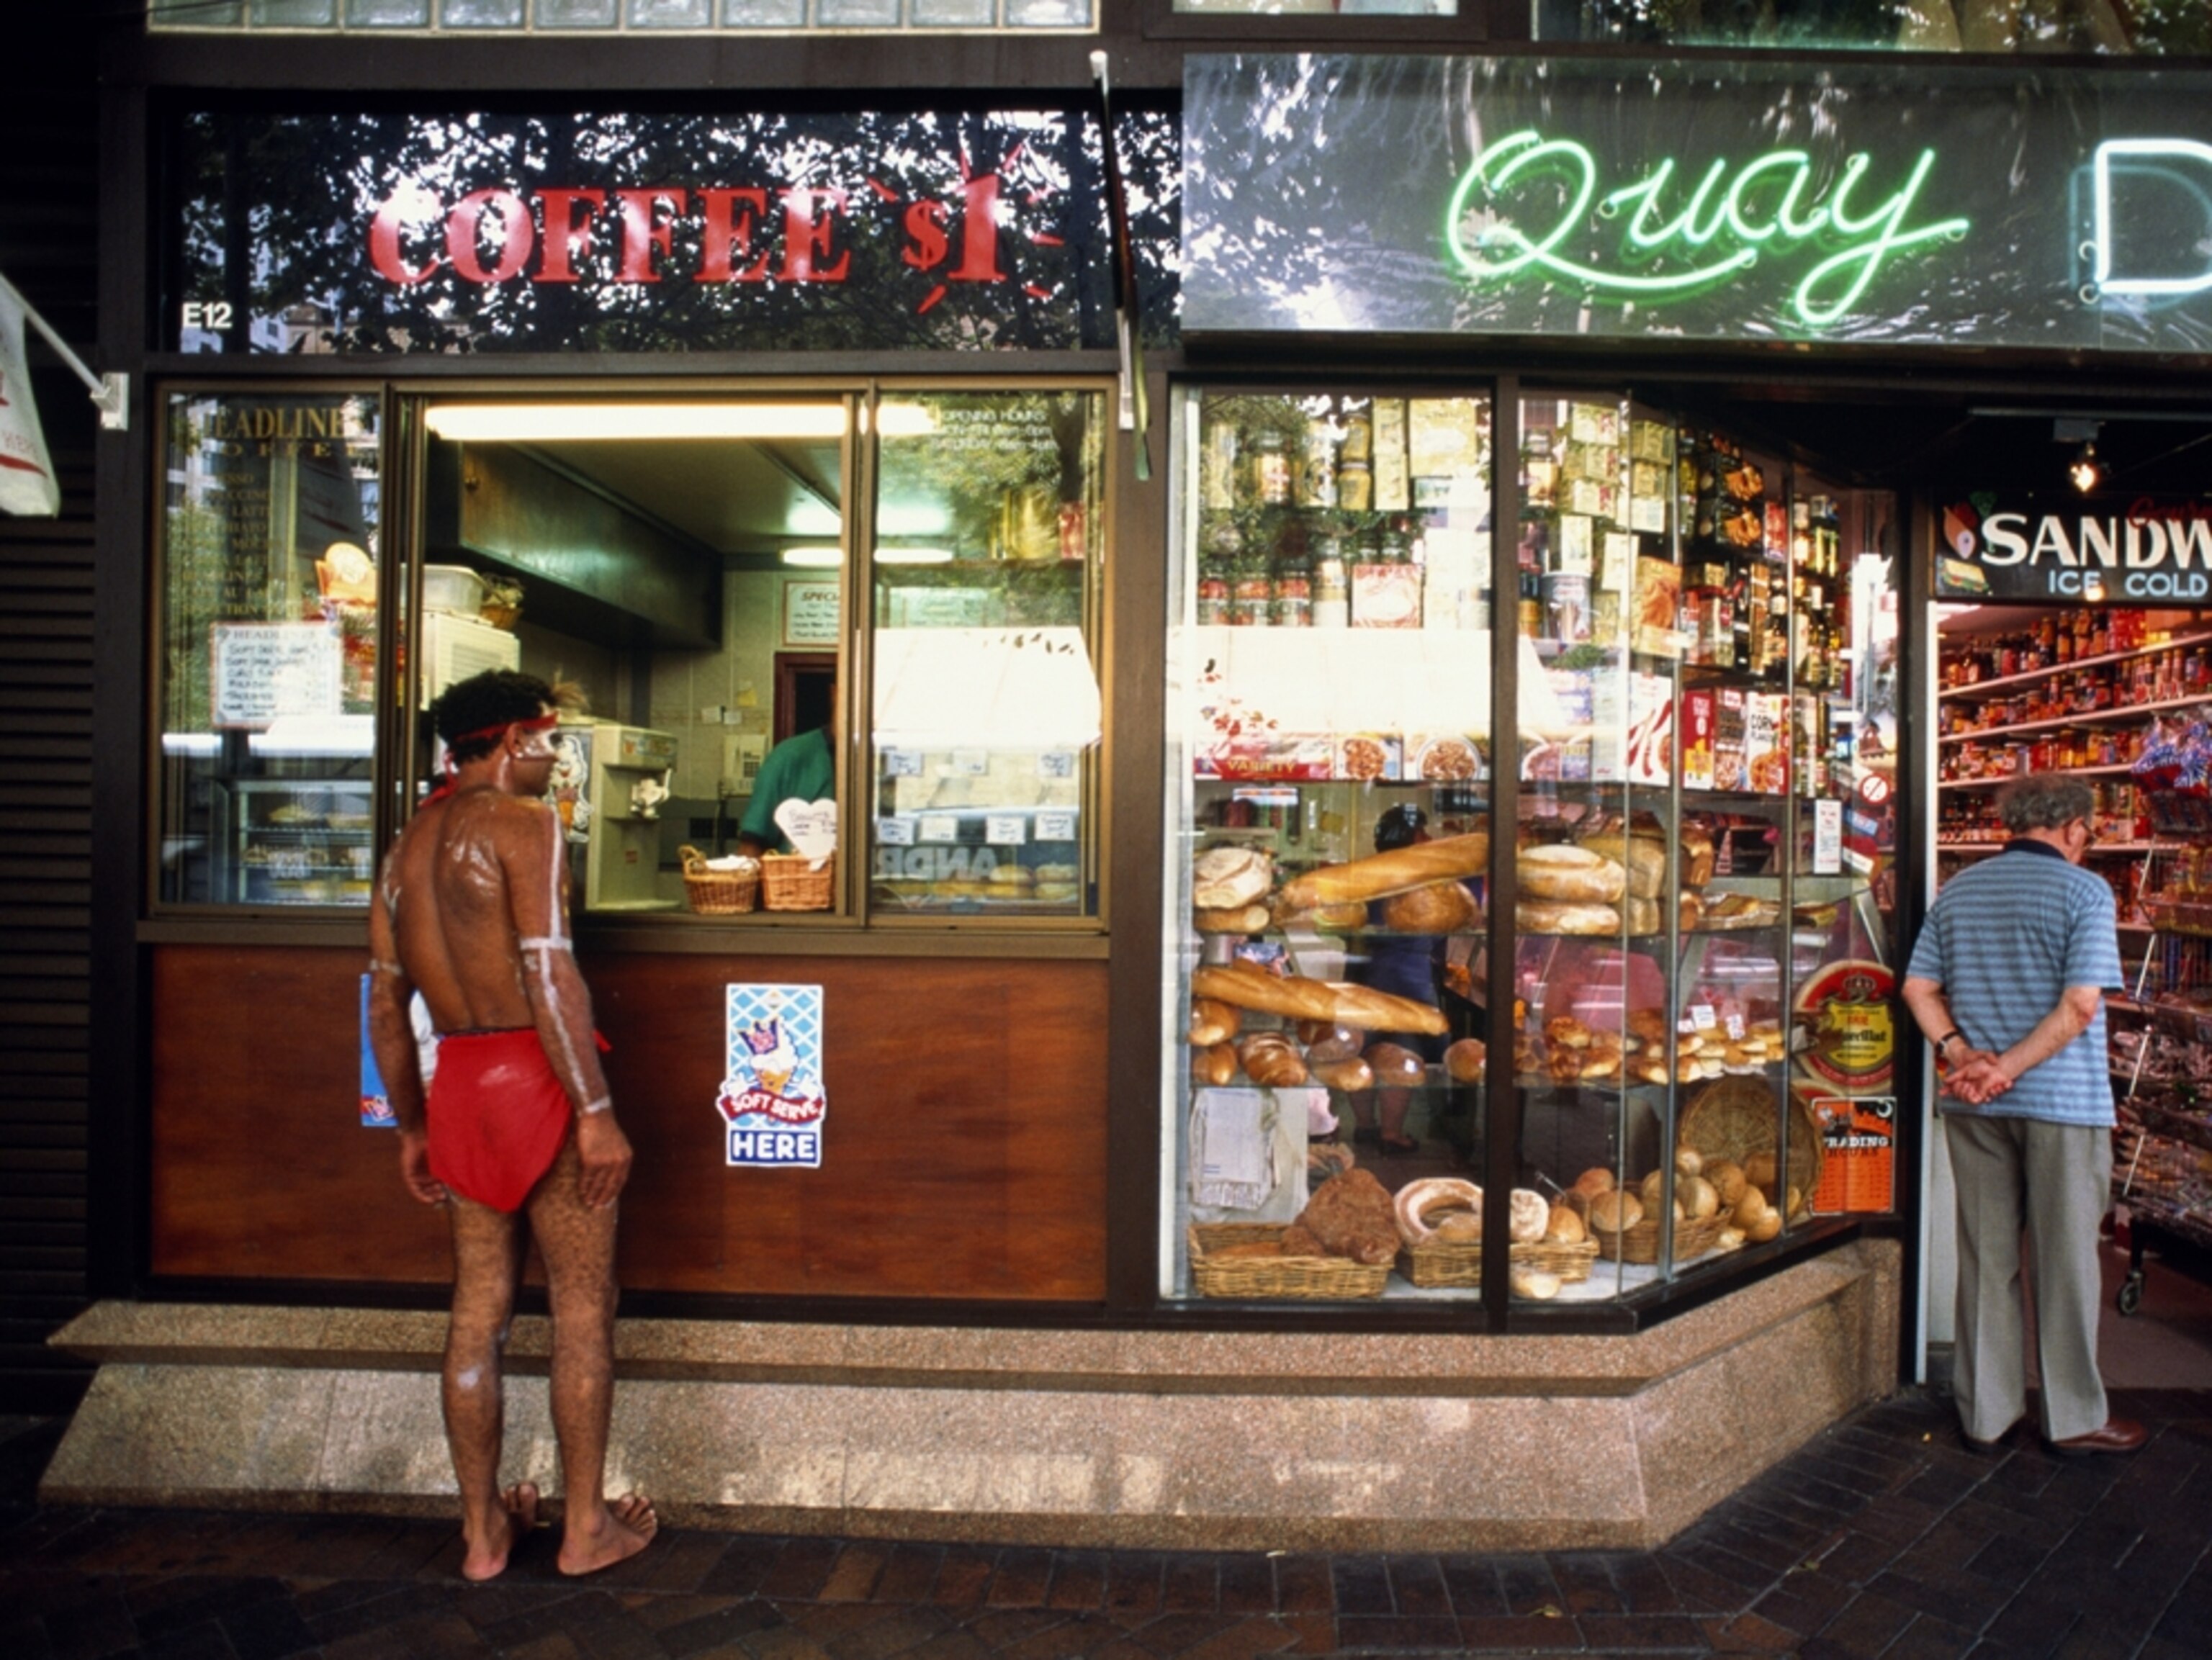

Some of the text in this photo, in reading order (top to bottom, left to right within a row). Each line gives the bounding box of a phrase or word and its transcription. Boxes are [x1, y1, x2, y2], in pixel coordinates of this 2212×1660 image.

[369, 186, 851, 284] COFFEE
[1445, 125, 1970, 326] Quay
[182, 302, 233, 329] E12
[2049, 569, 2209, 598] ICE COLD
[732, 1092, 771, 1112] SOFT
[732, 1132, 814, 1159] HERE
